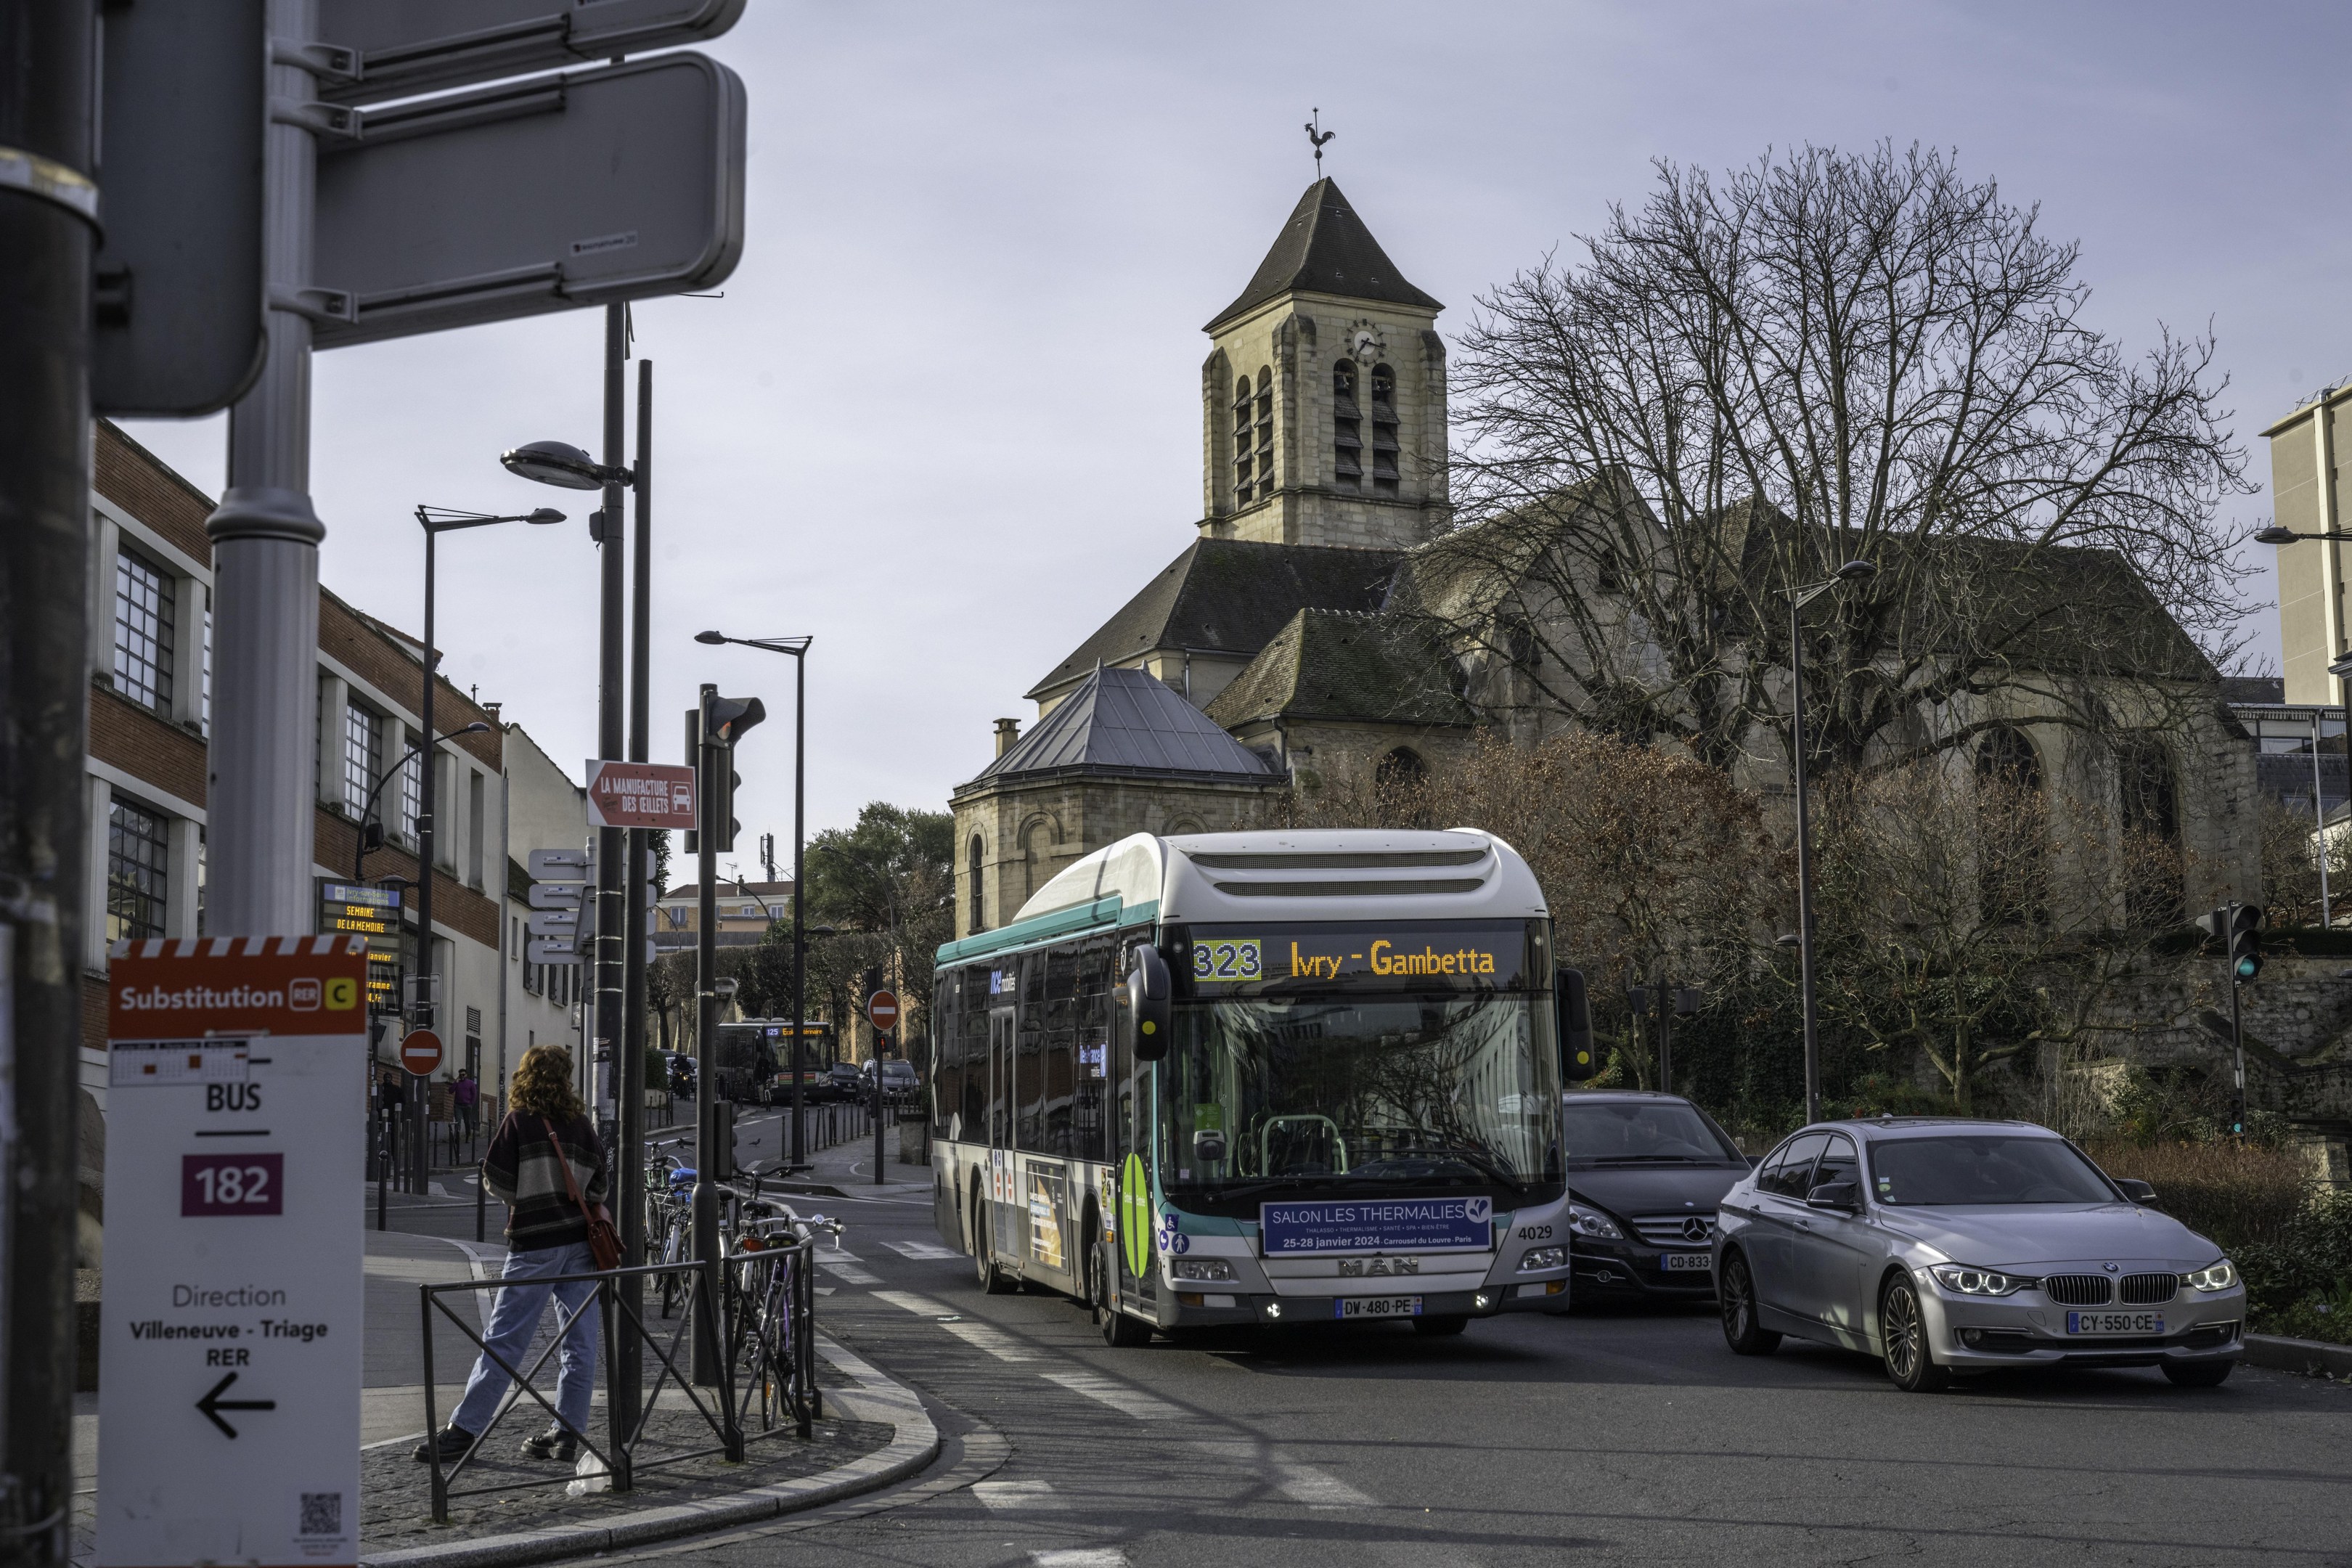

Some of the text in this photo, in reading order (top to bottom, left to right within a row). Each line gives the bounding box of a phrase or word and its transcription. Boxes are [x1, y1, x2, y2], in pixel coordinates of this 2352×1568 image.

[600, 777, 668, 796] LA MANUFACTURE
[622, 796, 637, 812] DES
[640, 797, 669, 814] ŒILLETS
[347, 888, 389, 899] Ivry-sur-Seine
[347, 895, 389, 905] Informations
[346, 906, 375, 918] SEMAINE
[337, 919, 385, 933] DE LA MEMOIRE
[1194, 943, 1260, 979] 323
[1291, 942, 1343, 979] Ivry
[1371, 940, 1495, 976] Gambetta
[120, 985, 284, 1010] Substitution
[333, 984, 348, 1003] C
[367, 993, 381, 1003] 4.fr
[207, 1083, 261, 1112] BUS
[195, 1166, 269, 1204] 182
[1273, 1204, 1465, 1224] SALON LES THERMALIES
[1518, 1225, 1552, 1240] 4029
[1283, 1238, 1313, 1248] 25-28
[1316, 1236, 1352, 1249] janvier
[1355, 1236, 1380, 1246] 2024
[1338, 1257, 1418, 1277] MAN
[172, 1283, 286, 1307] Direction
[129, 1320, 240, 1340] Villeneuve
[260, 1319, 328, 1342] Triage
[206, 1349, 250, 1367] RER
